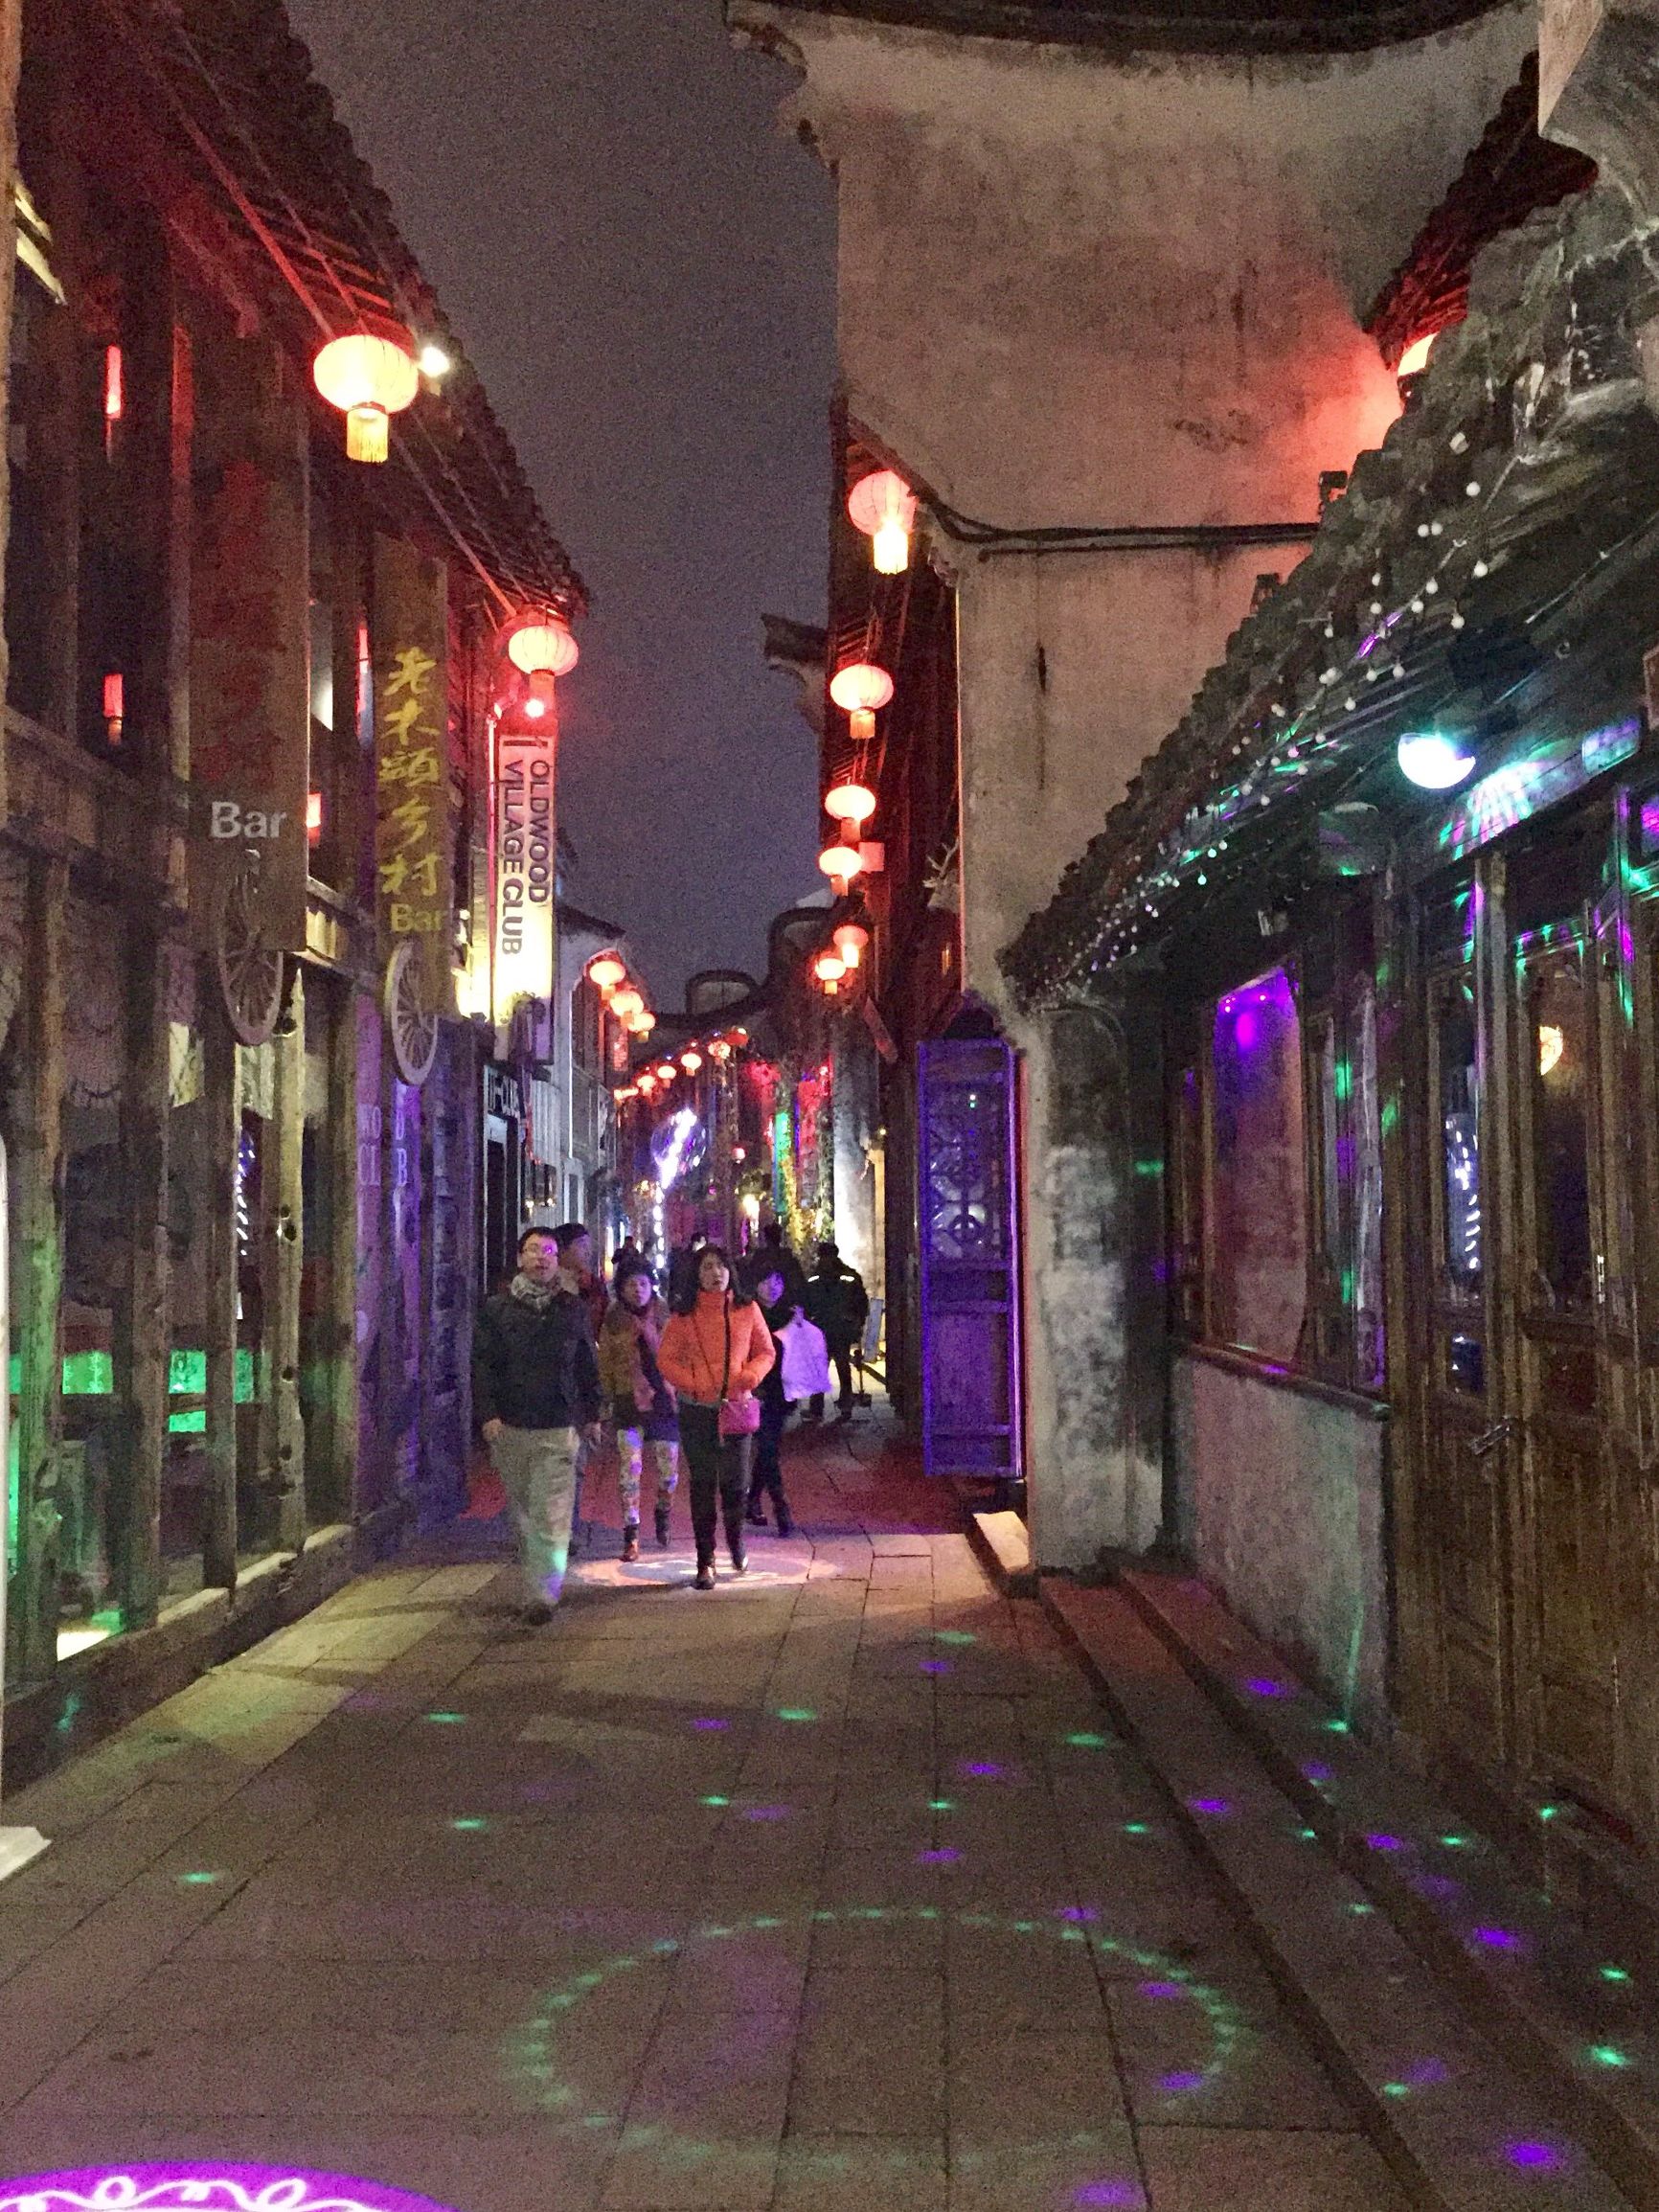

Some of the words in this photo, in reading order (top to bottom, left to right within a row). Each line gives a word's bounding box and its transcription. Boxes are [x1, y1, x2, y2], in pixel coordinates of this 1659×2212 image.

[212, 801, 286, 838] Bar
[503, 759, 524, 875] VILLAGE
[529, 760, 550, 902] OLDWOOD
[391, 903, 447, 931] Bar
[501, 878, 524, 955] CLUB
